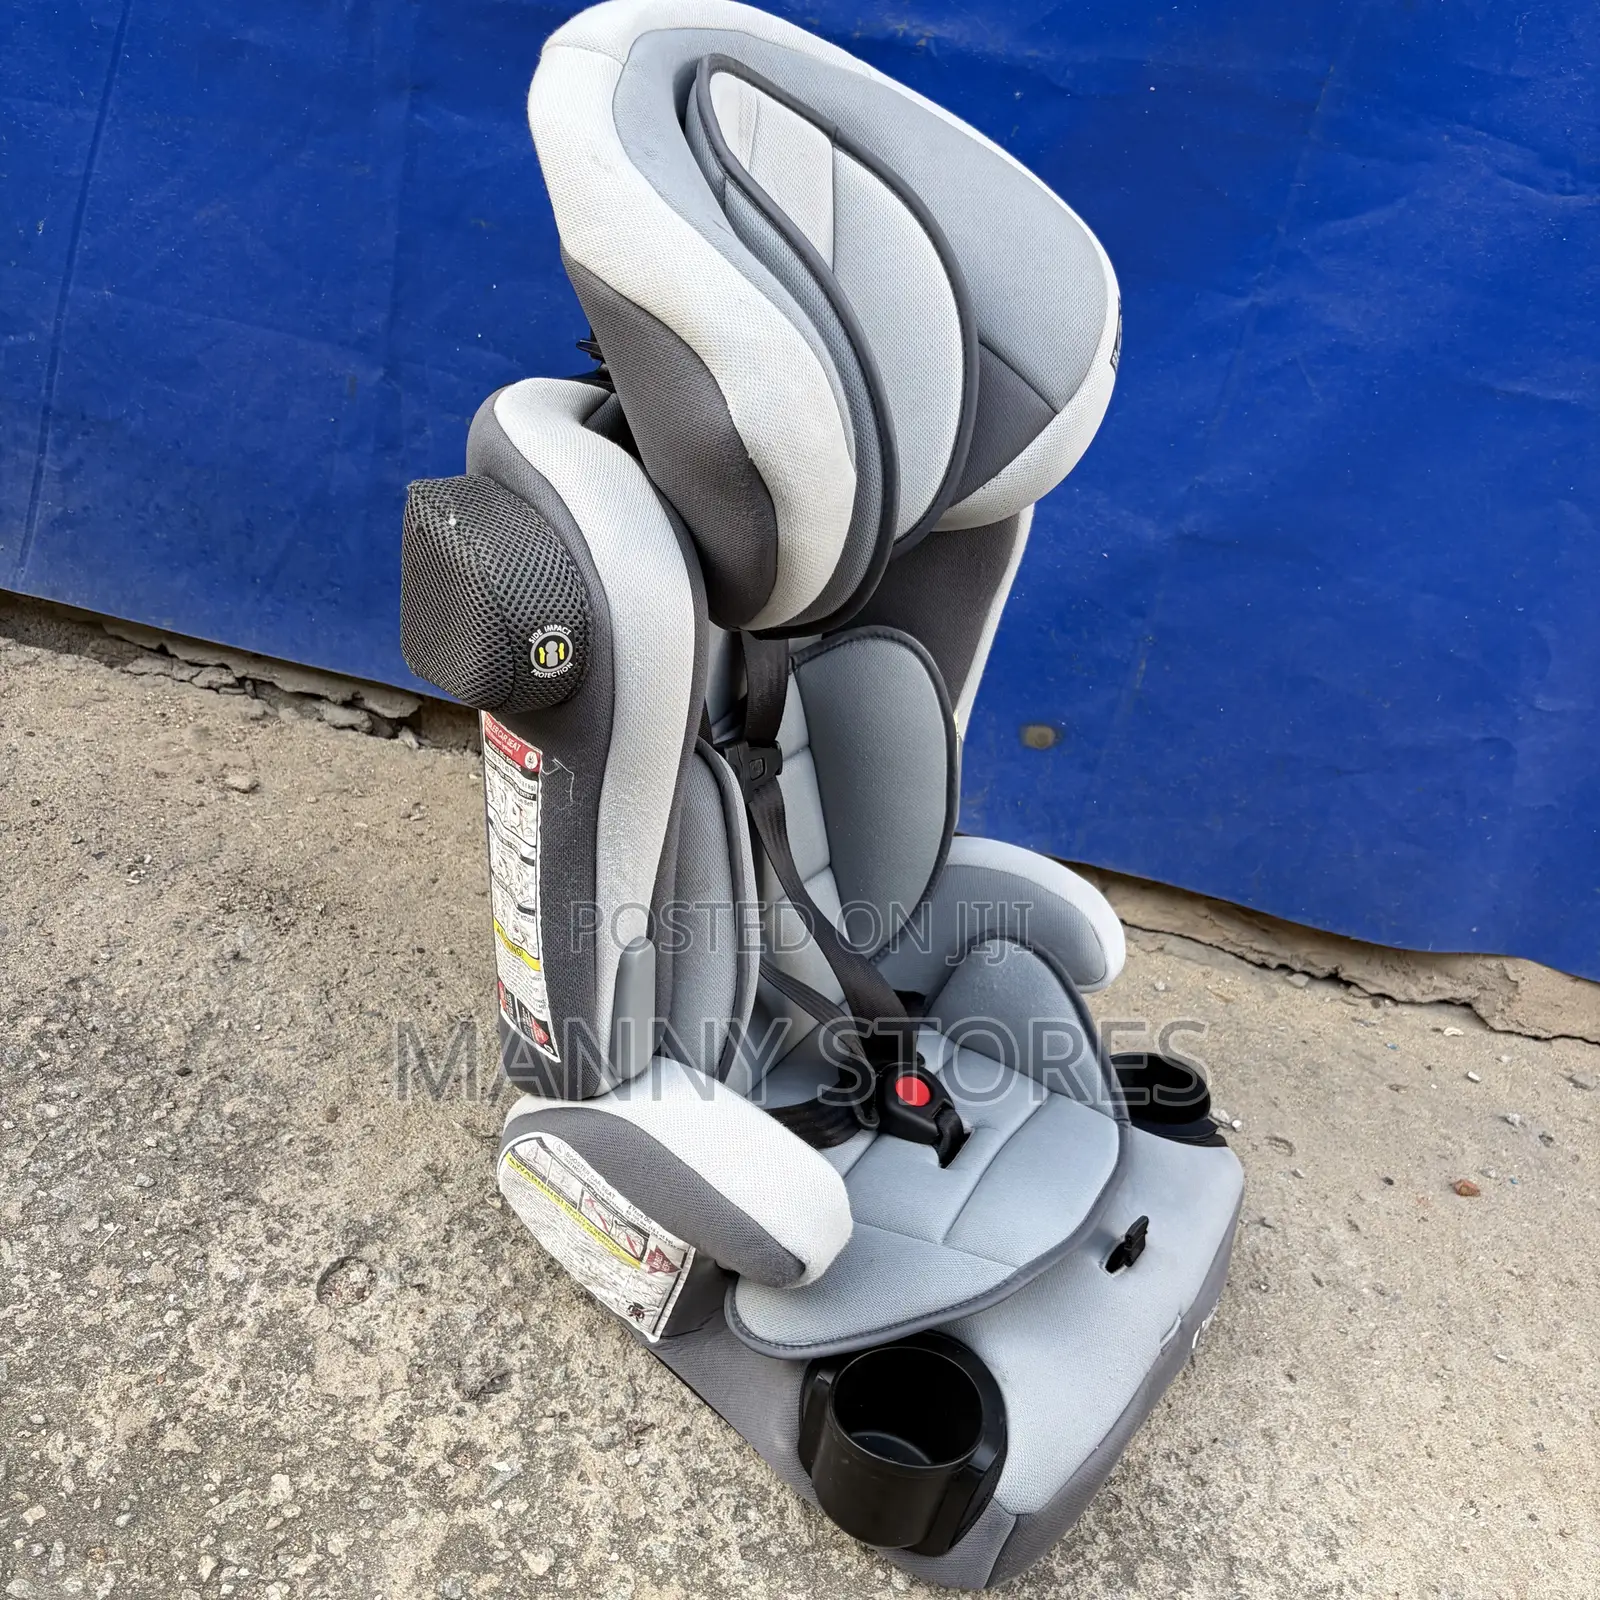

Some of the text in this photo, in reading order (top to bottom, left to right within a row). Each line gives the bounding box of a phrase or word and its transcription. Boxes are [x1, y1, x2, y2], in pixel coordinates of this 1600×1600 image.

[528, 624, 572, 643] SIDE IMPACT
[530, 662, 573, 678] PROTECTION
[514, 1162, 564, 1206] WARNING!
[602, 1185, 616, 1199] SEAT
